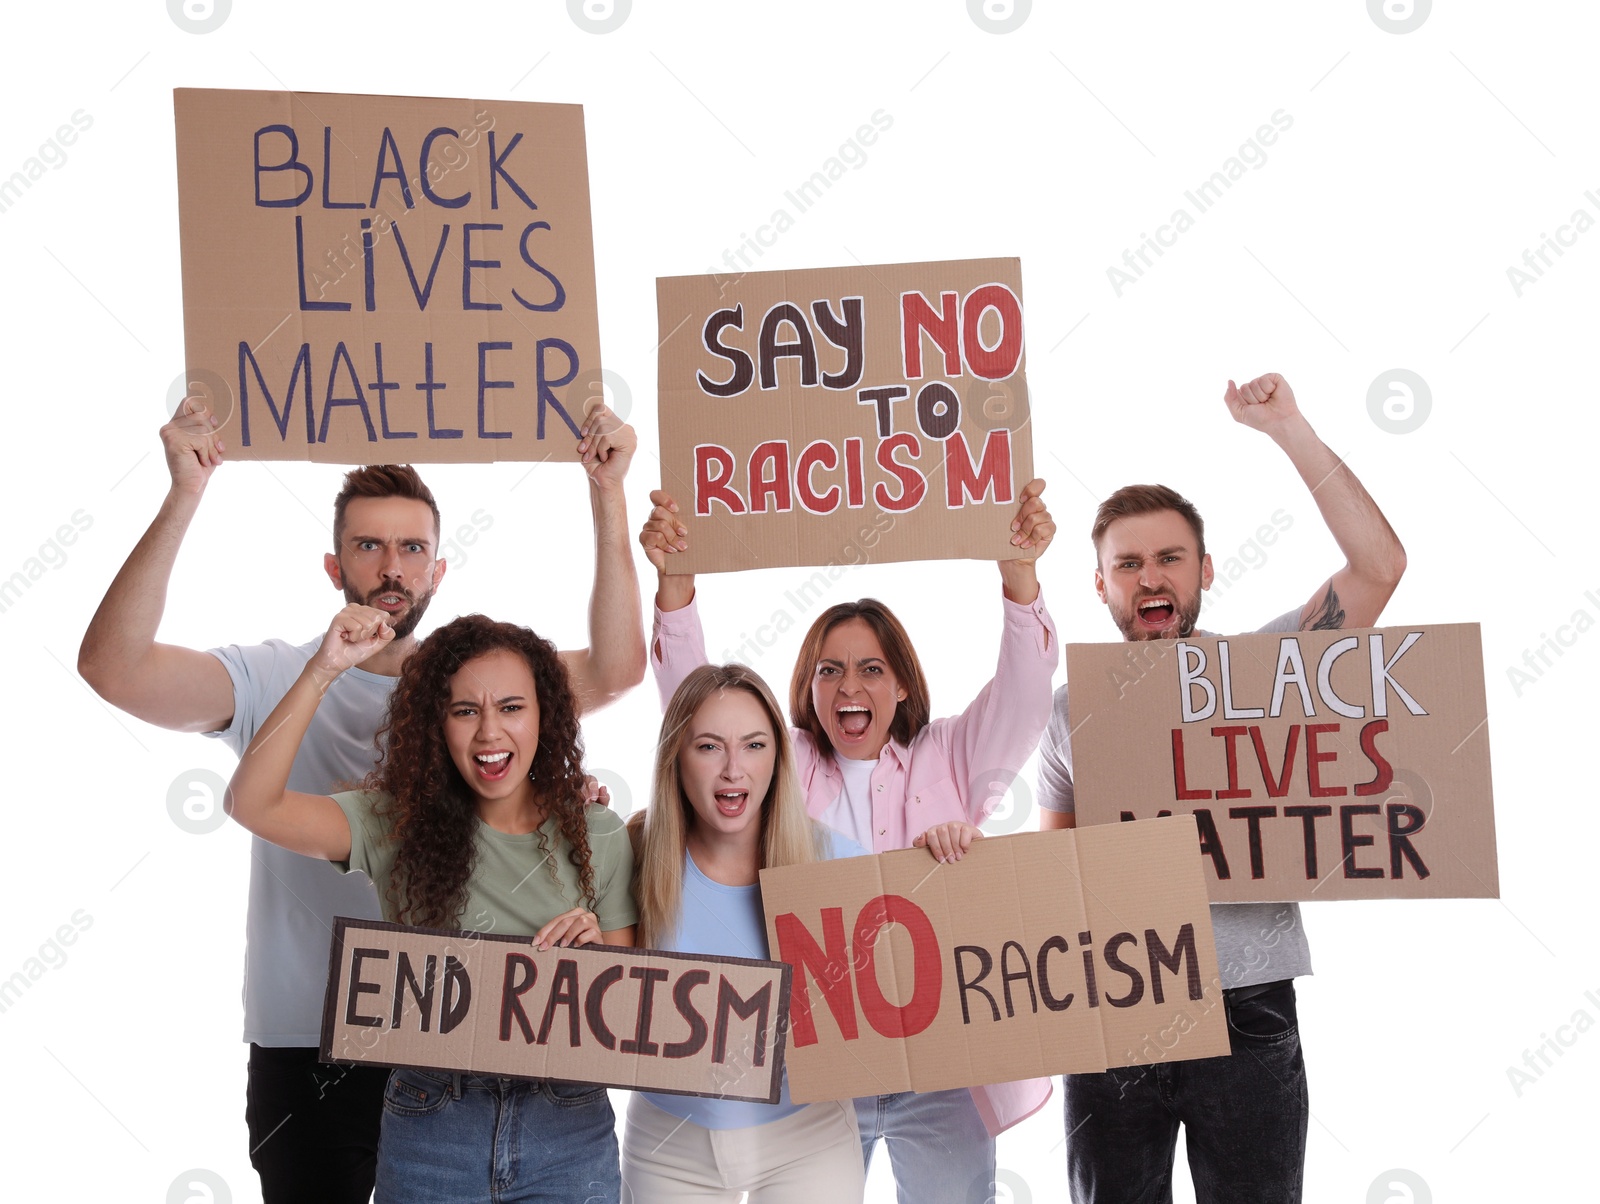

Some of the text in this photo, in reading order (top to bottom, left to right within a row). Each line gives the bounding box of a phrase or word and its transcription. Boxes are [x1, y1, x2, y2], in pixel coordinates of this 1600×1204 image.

[253, 124, 538, 210] BLACK
[696, 282, 1024, 398] SAY NO
[856, 381, 961, 441] TO
[693, 428, 1014, 516] RACISM
[1175, 631, 1430, 723] BLACK
[1171, 719, 1394, 800] LIVES
[1120, 803, 1430, 880] ATTER
[345, 947, 772, 1067] END RACISM
[775, 894, 942, 1048] NO
